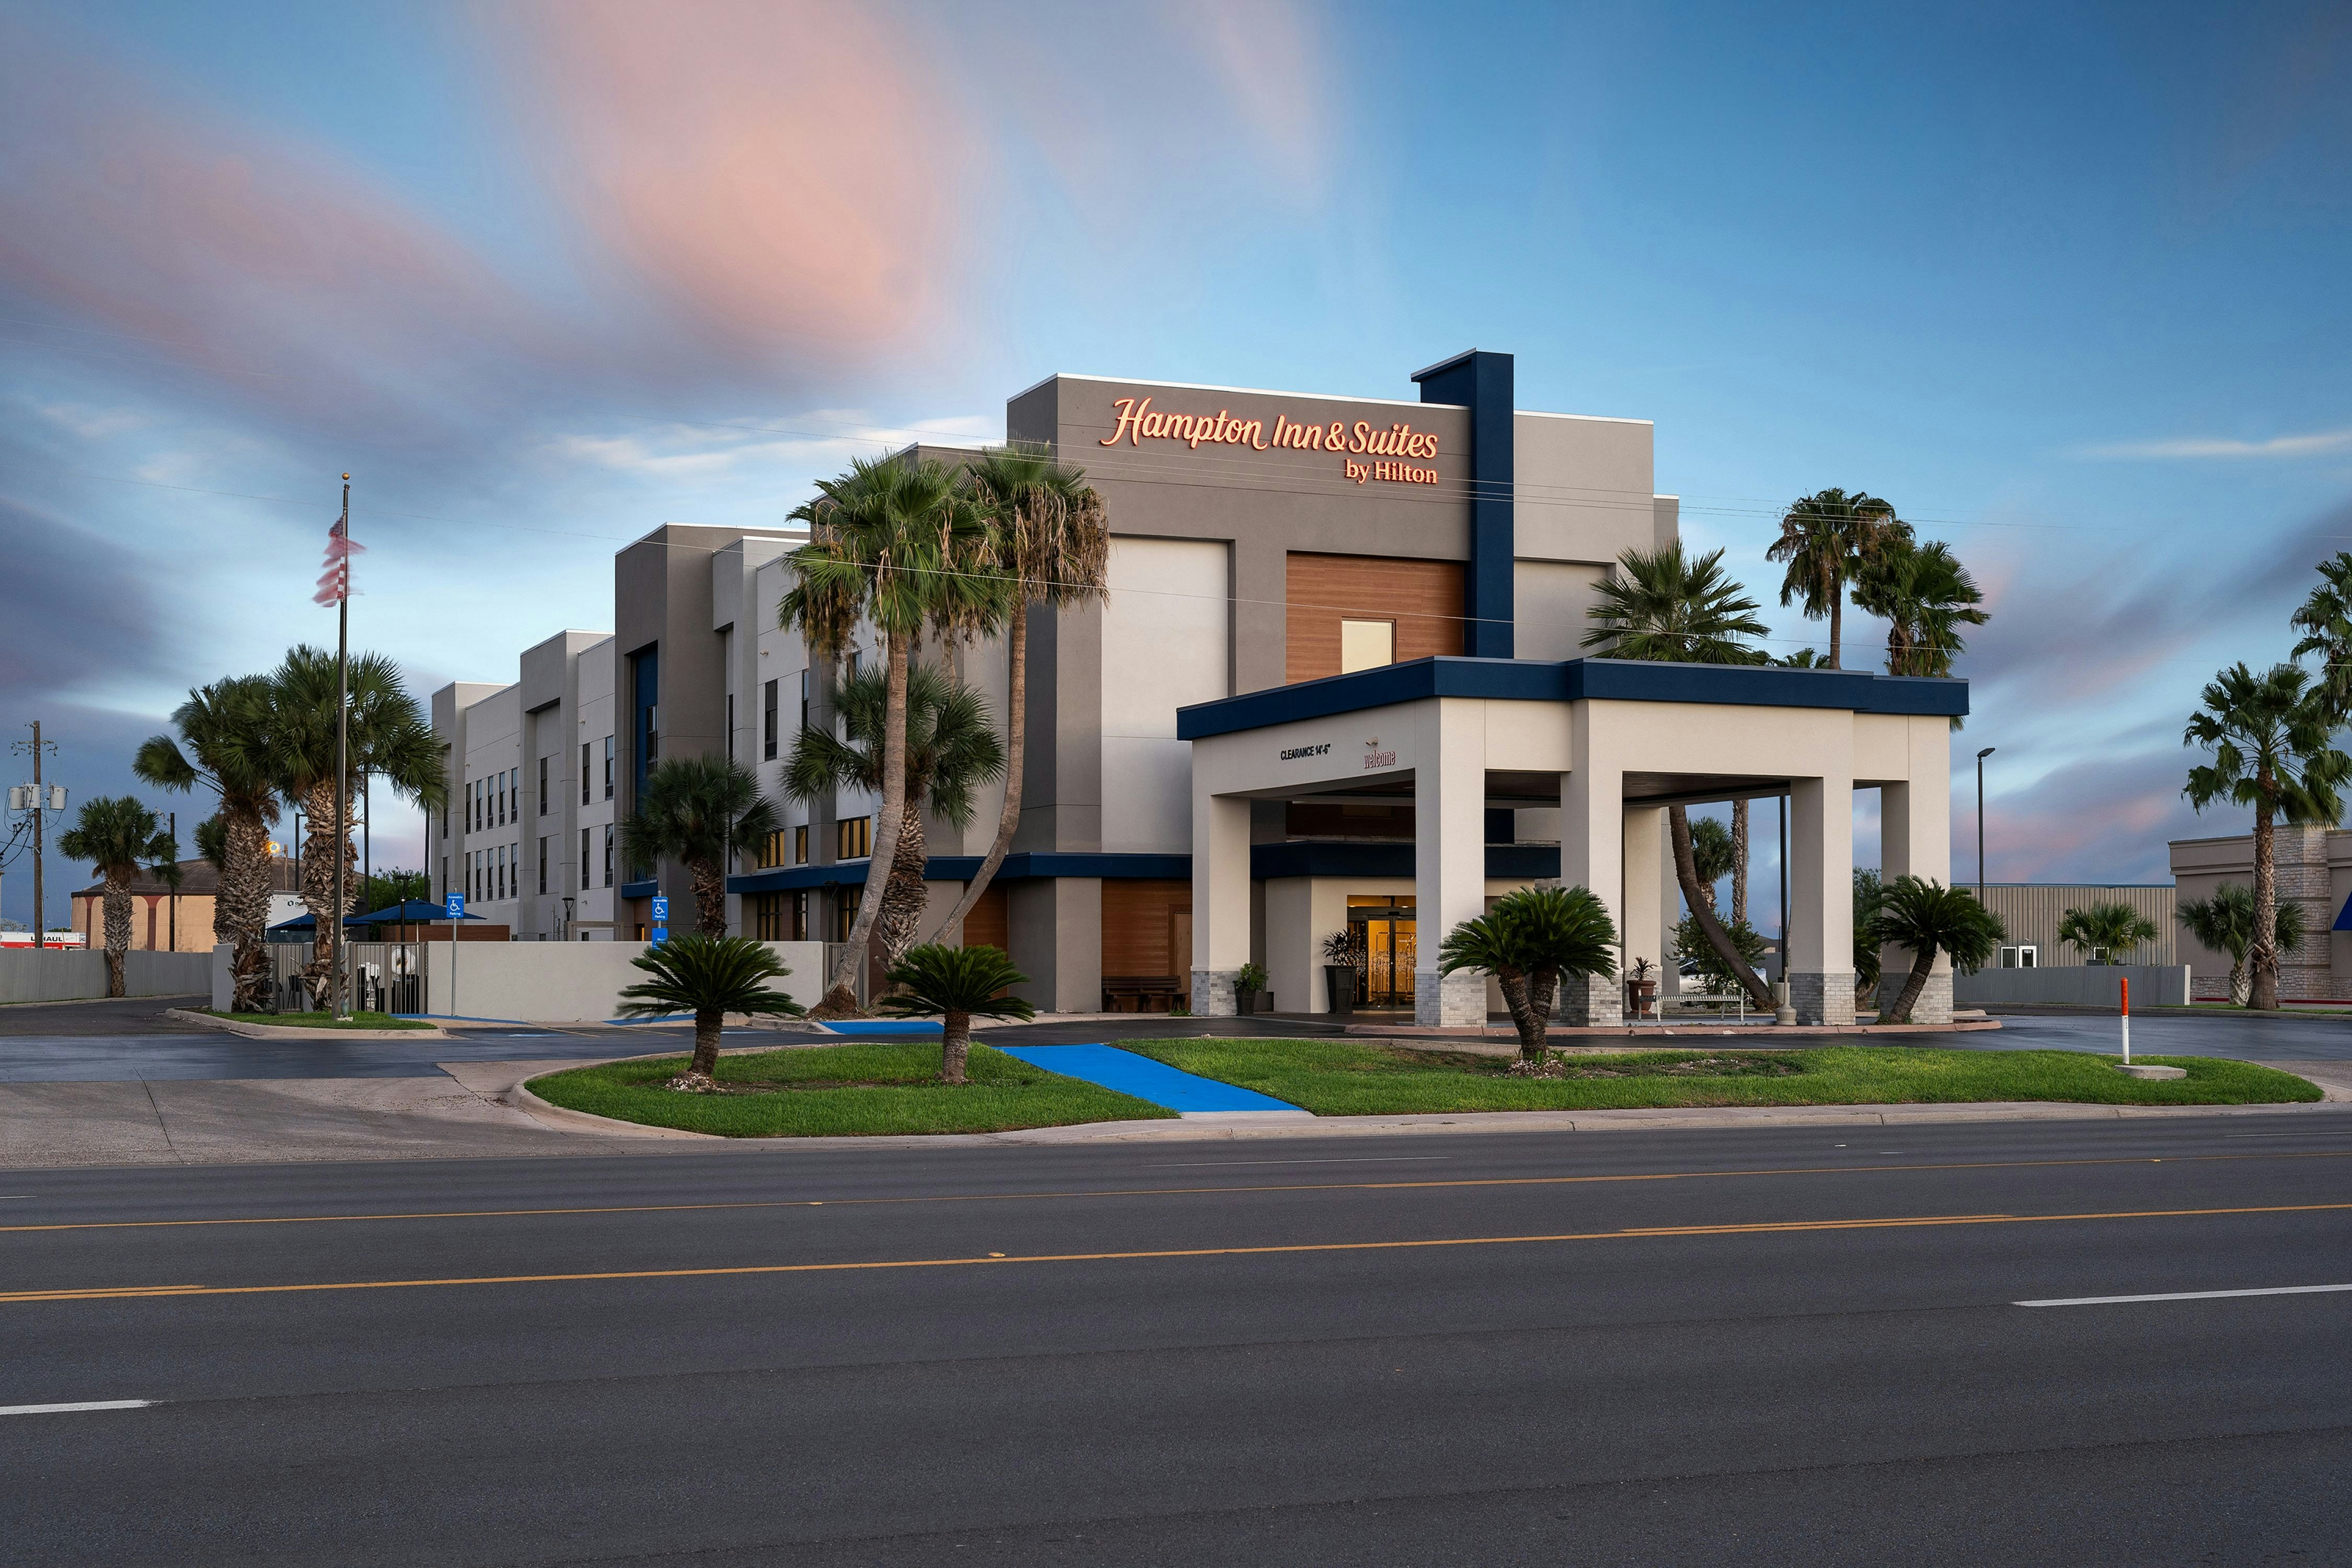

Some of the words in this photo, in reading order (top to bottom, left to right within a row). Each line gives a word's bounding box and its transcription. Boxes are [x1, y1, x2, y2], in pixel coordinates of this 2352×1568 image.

[1100, 397, 1268, 451] Hampton
[1272, 414, 1320, 450] Inn
[1348, 421, 1438, 459] Suites
[1345, 458, 1370, 484] by
[1374, 460, 1438, 484] Hilton
[1281, 746, 1315, 760] CLEARANCE
[1364, 750, 1396, 769] welcome
